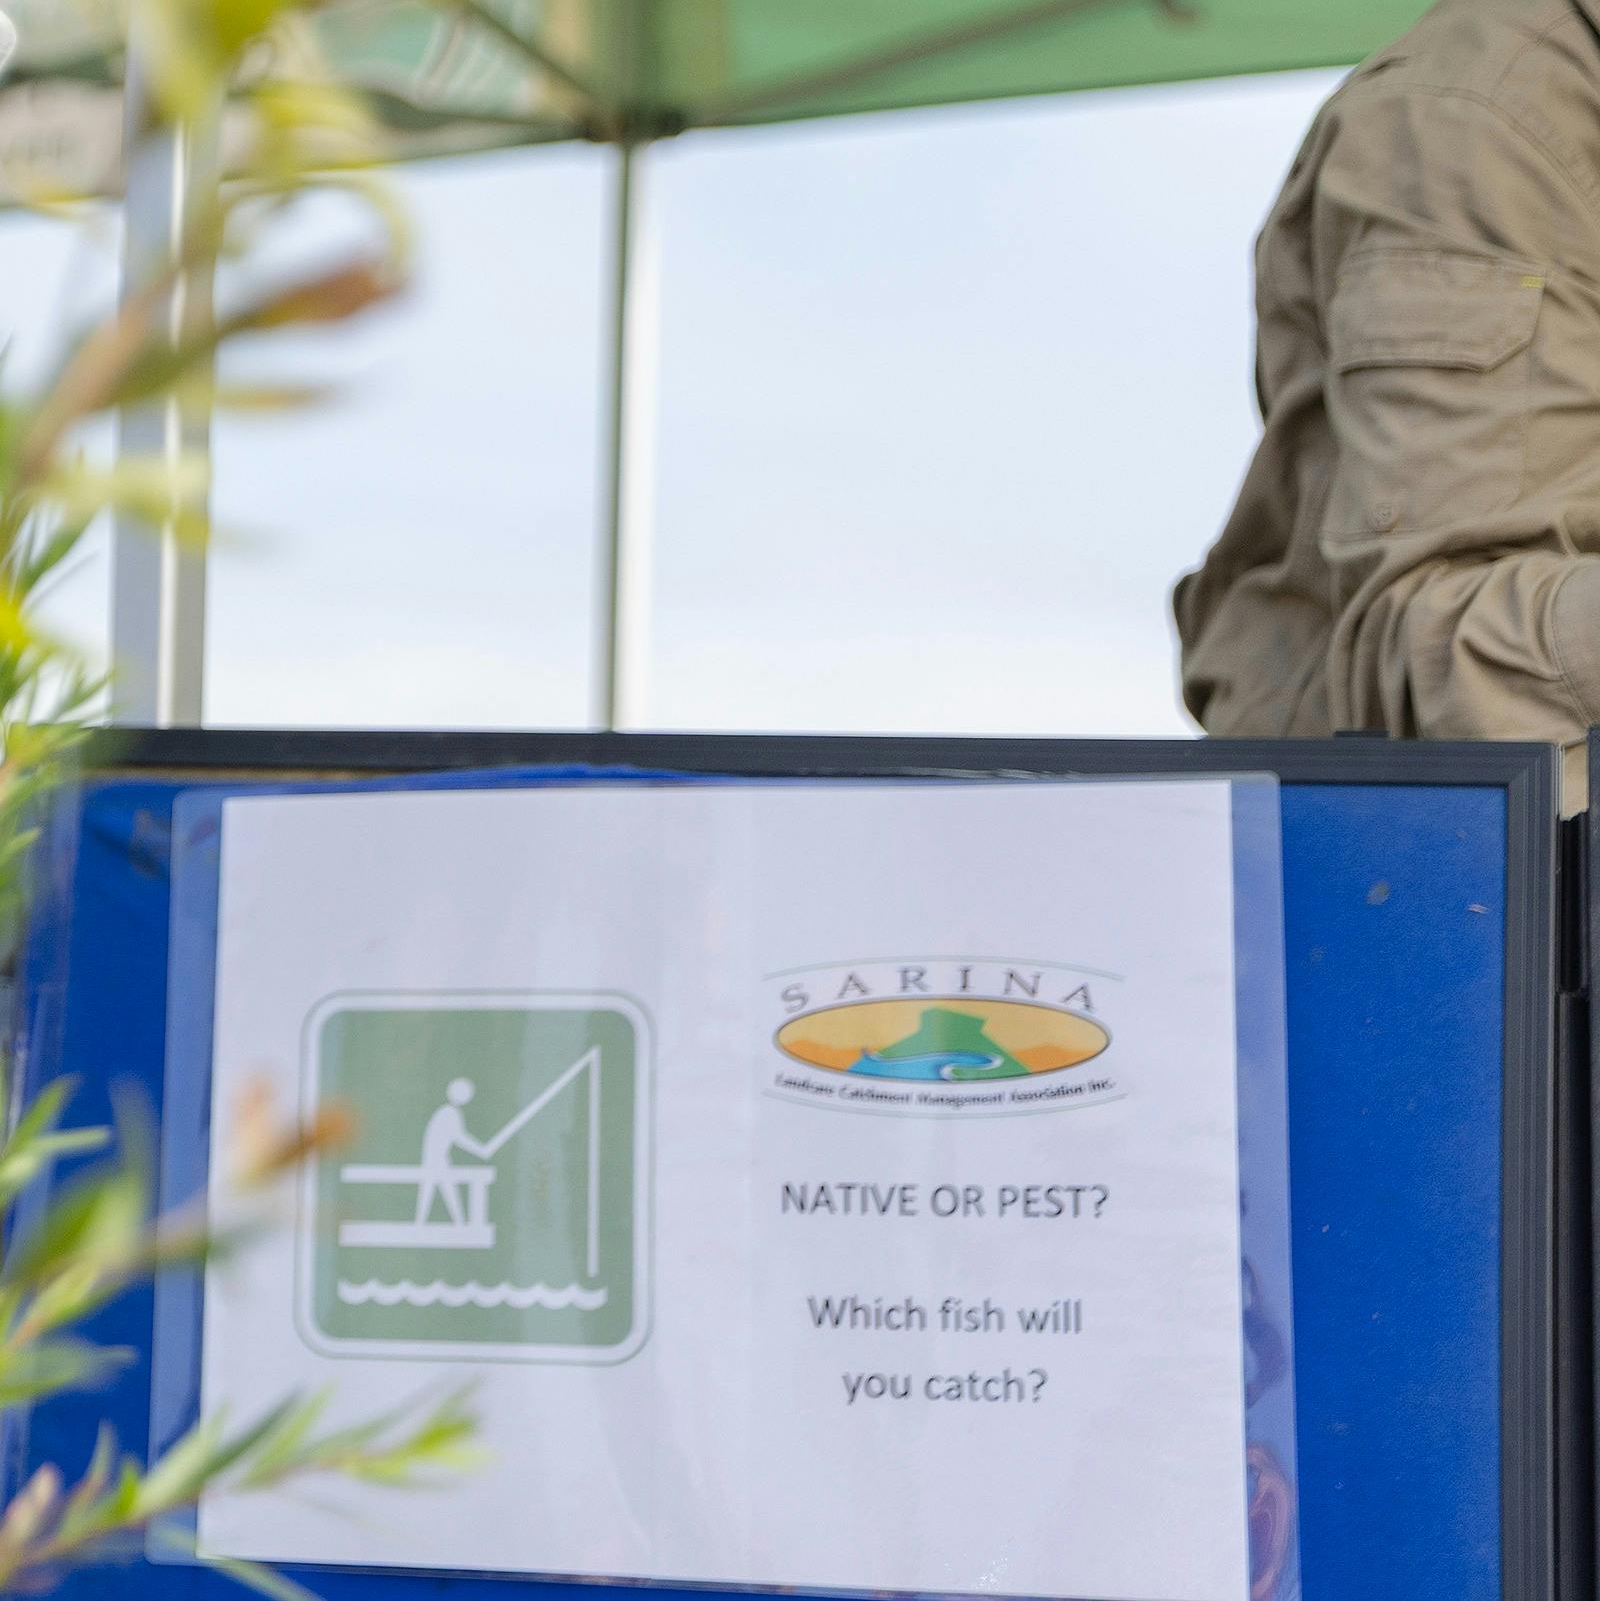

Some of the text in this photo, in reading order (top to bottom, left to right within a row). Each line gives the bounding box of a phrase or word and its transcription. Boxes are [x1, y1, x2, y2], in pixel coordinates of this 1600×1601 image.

[780, 964, 1096, 1014] SARINA
[780, 1182, 1110, 1219] NATIVE OR PEST?
[807, 1295, 1082, 1335] Which fish will
[843, 1367, 1048, 1405] you catch?
